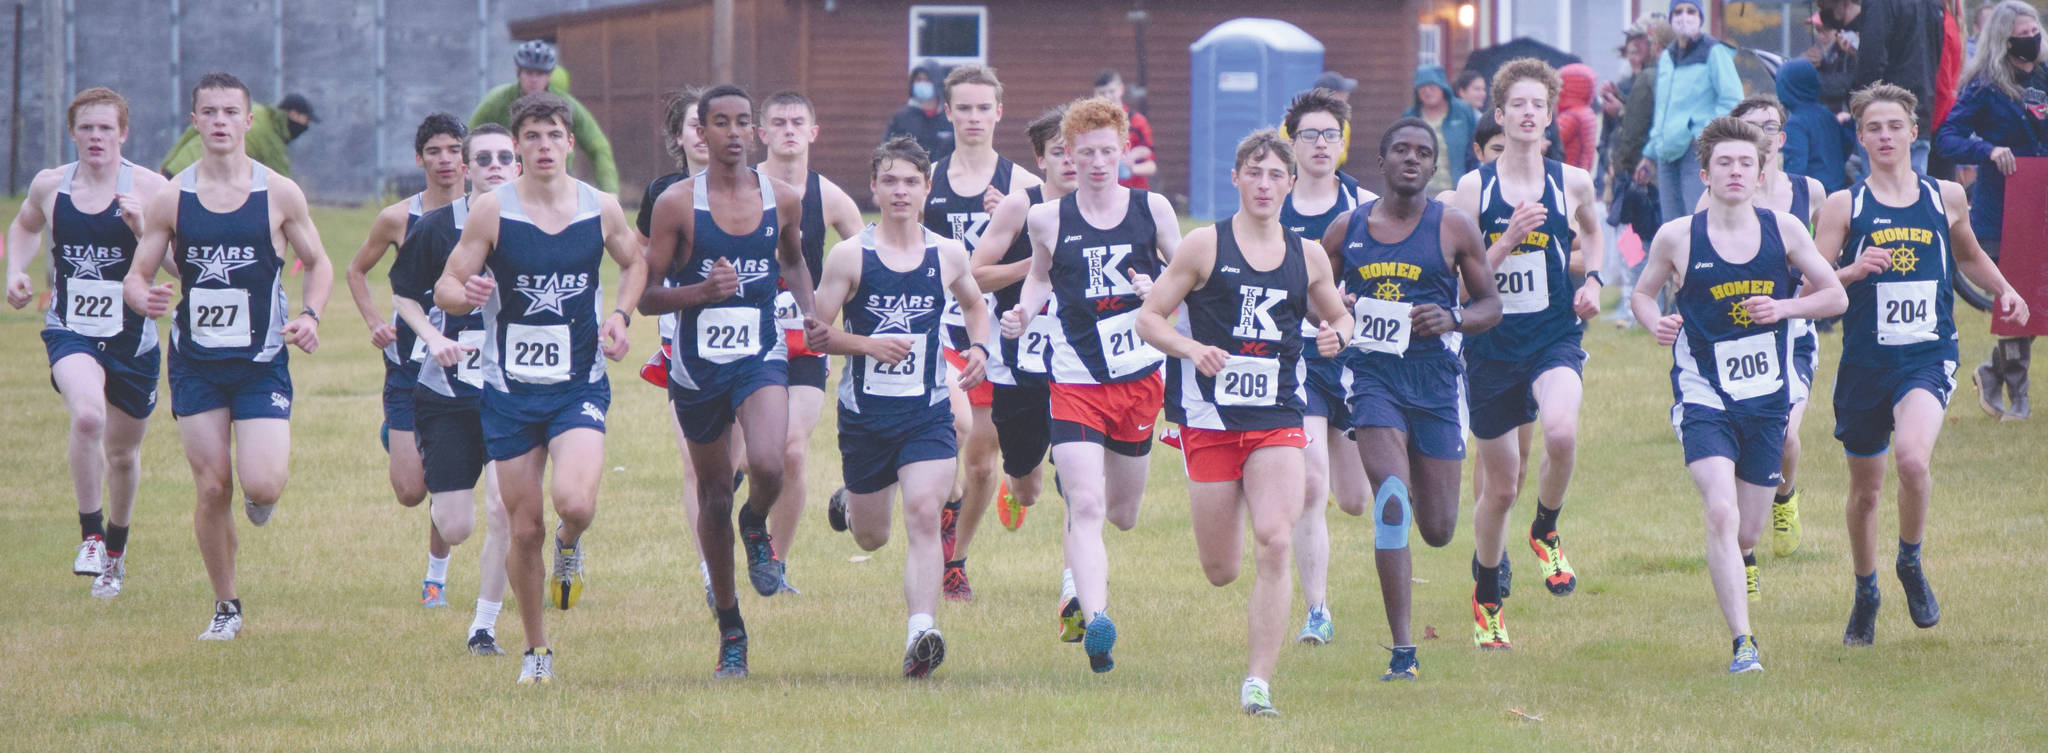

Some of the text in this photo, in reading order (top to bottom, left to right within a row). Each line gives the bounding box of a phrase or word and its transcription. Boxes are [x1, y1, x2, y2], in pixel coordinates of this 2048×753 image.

[953, 215, 963, 240] KEN
[1870, 227, 1934, 246] HOMER
[63, 244, 122, 259] STARS
[187, 244, 255, 259] STARS
[701, 256, 769, 272] SARS
[1082, 243, 1137, 298] K
[1090, 249, 1102, 295] KENAI
[1358, 262, 1423, 281] HOMER
[515, 272, 589, 288] STARS
[1494, 269, 1535, 294] 201
[1709, 280, 1775, 301] HOMER
[74, 294, 113, 318] 222
[867, 293, 936, 308] STARS
[1096, 296, 1126, 312] XC
[1232, 284, 1289, 341] K
[1242, 287, 1256, 336] KENAI
[1886, 299, 1927, 324] 204
[197, 304, 239, 328] 227
[706, 325, 750, 349] 224
[1360, 314, 1401, 343] 202
[514, 341, 559, 367] 226
[1239, 340, 1270, 356] XC
[1726, 351, 1769, 381] 206
[1224, 371, 1268, 398] 209
